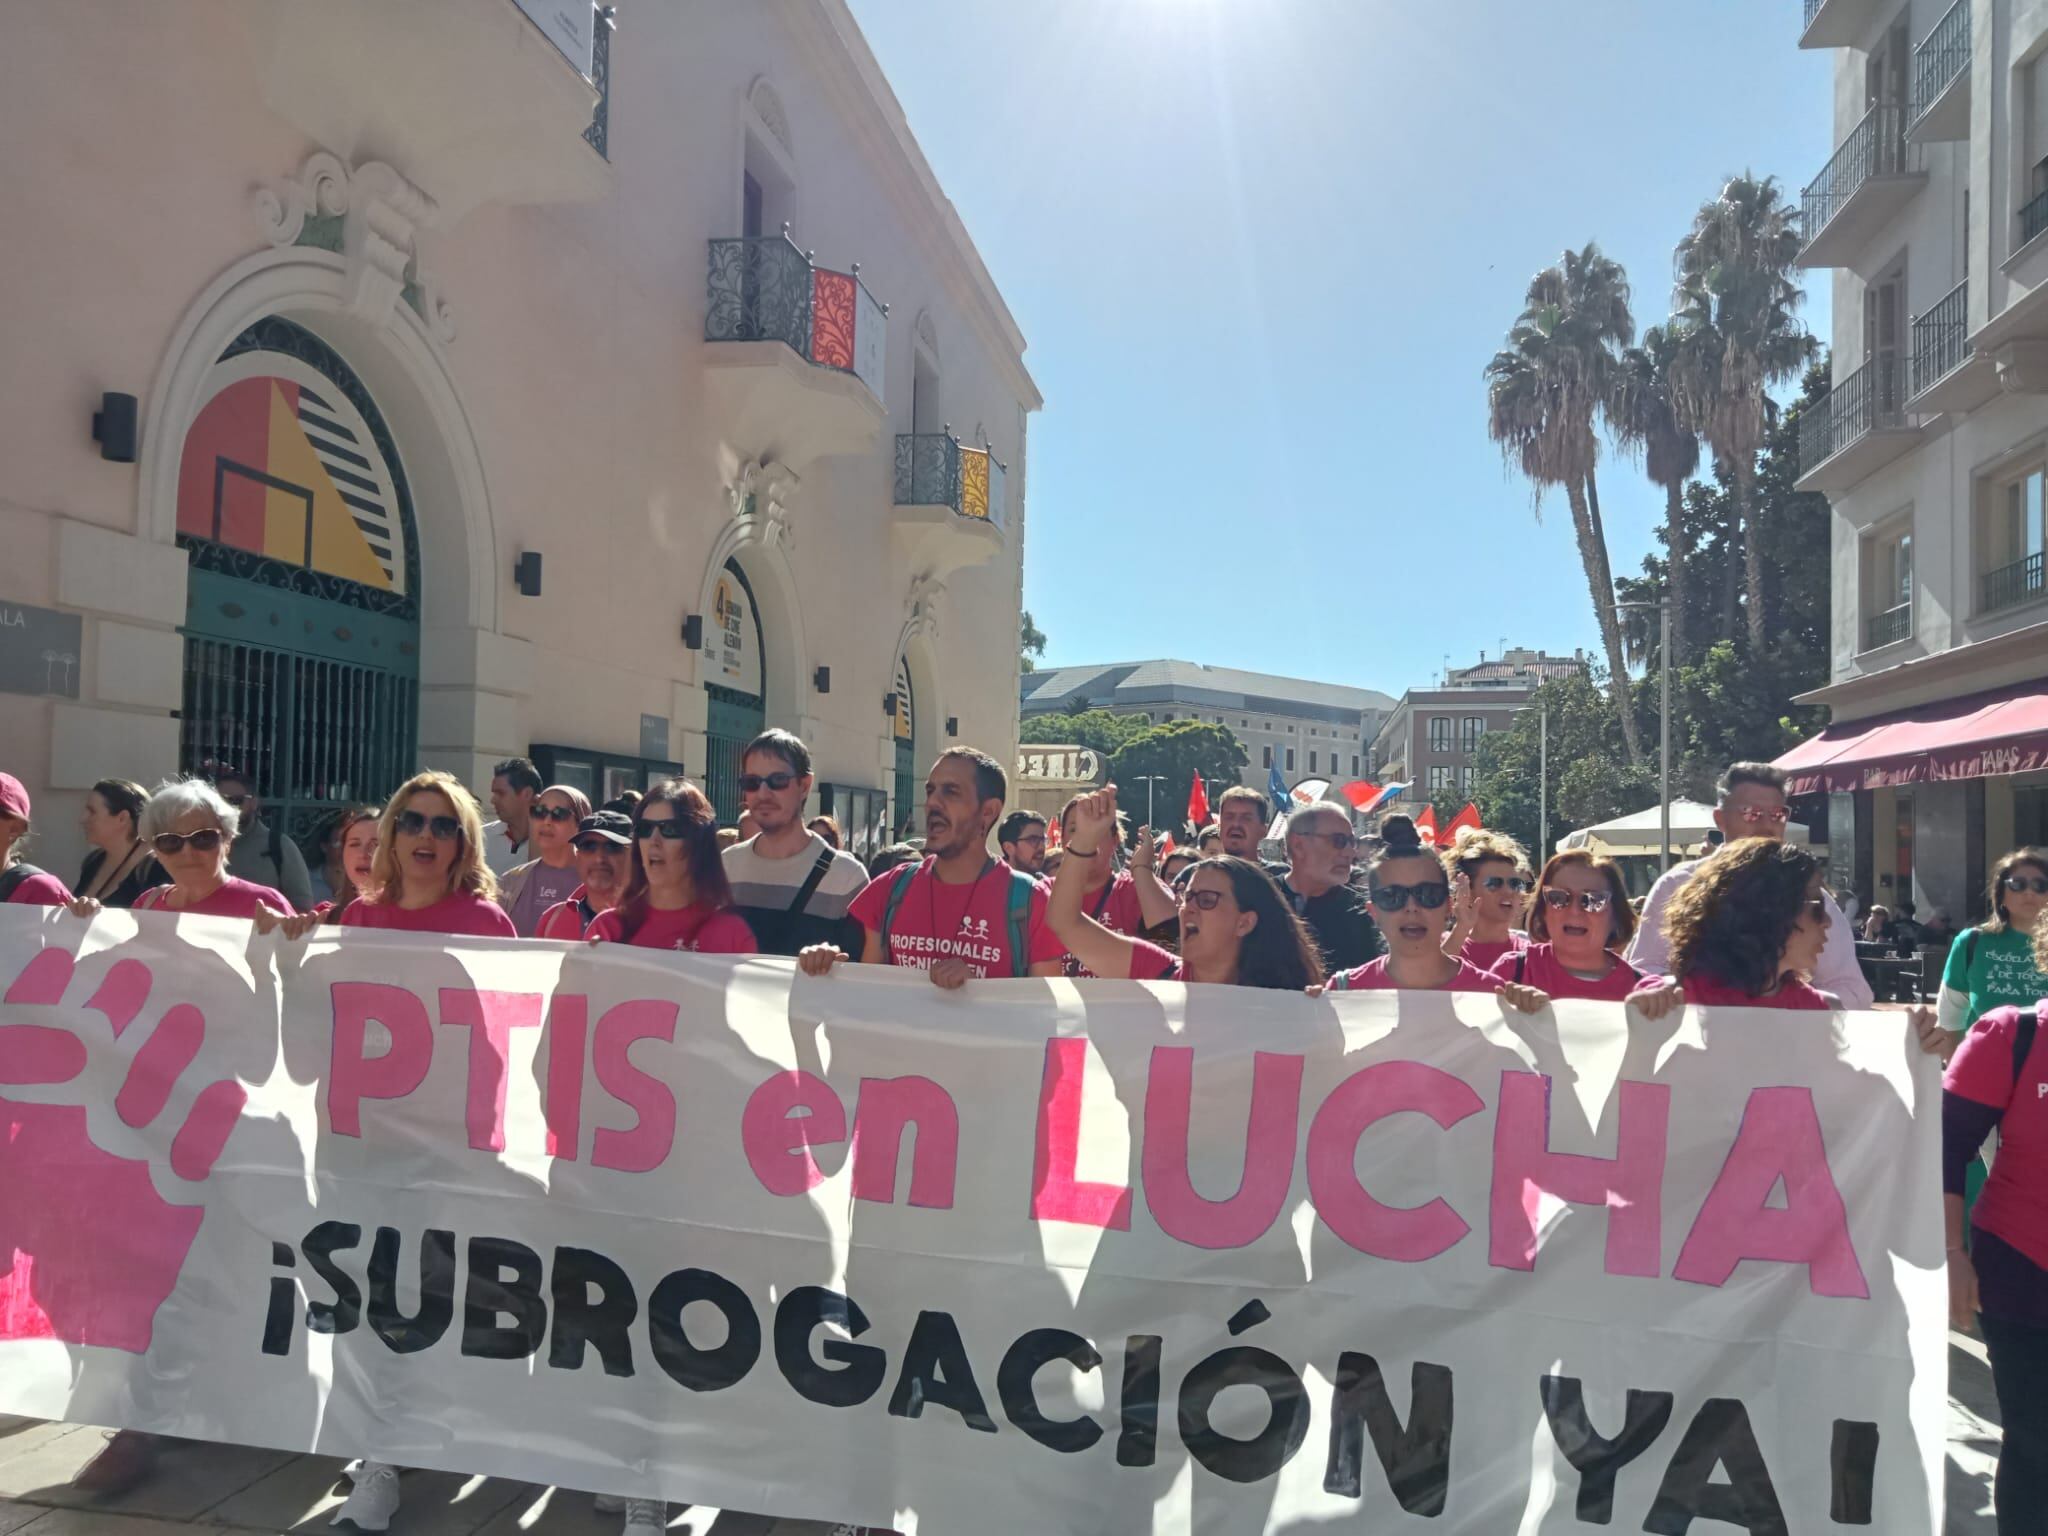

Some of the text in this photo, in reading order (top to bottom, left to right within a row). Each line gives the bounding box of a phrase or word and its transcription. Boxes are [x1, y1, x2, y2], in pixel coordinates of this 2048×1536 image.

[540, 886, 557, 897] Lee
[890, 934, 1001, 963] PROFESIONALES
[328, 981, 1870, 1300] PTIS en LUCHA
[262, 1220, 1453, 1518] ¡SUBROGACIÓN
